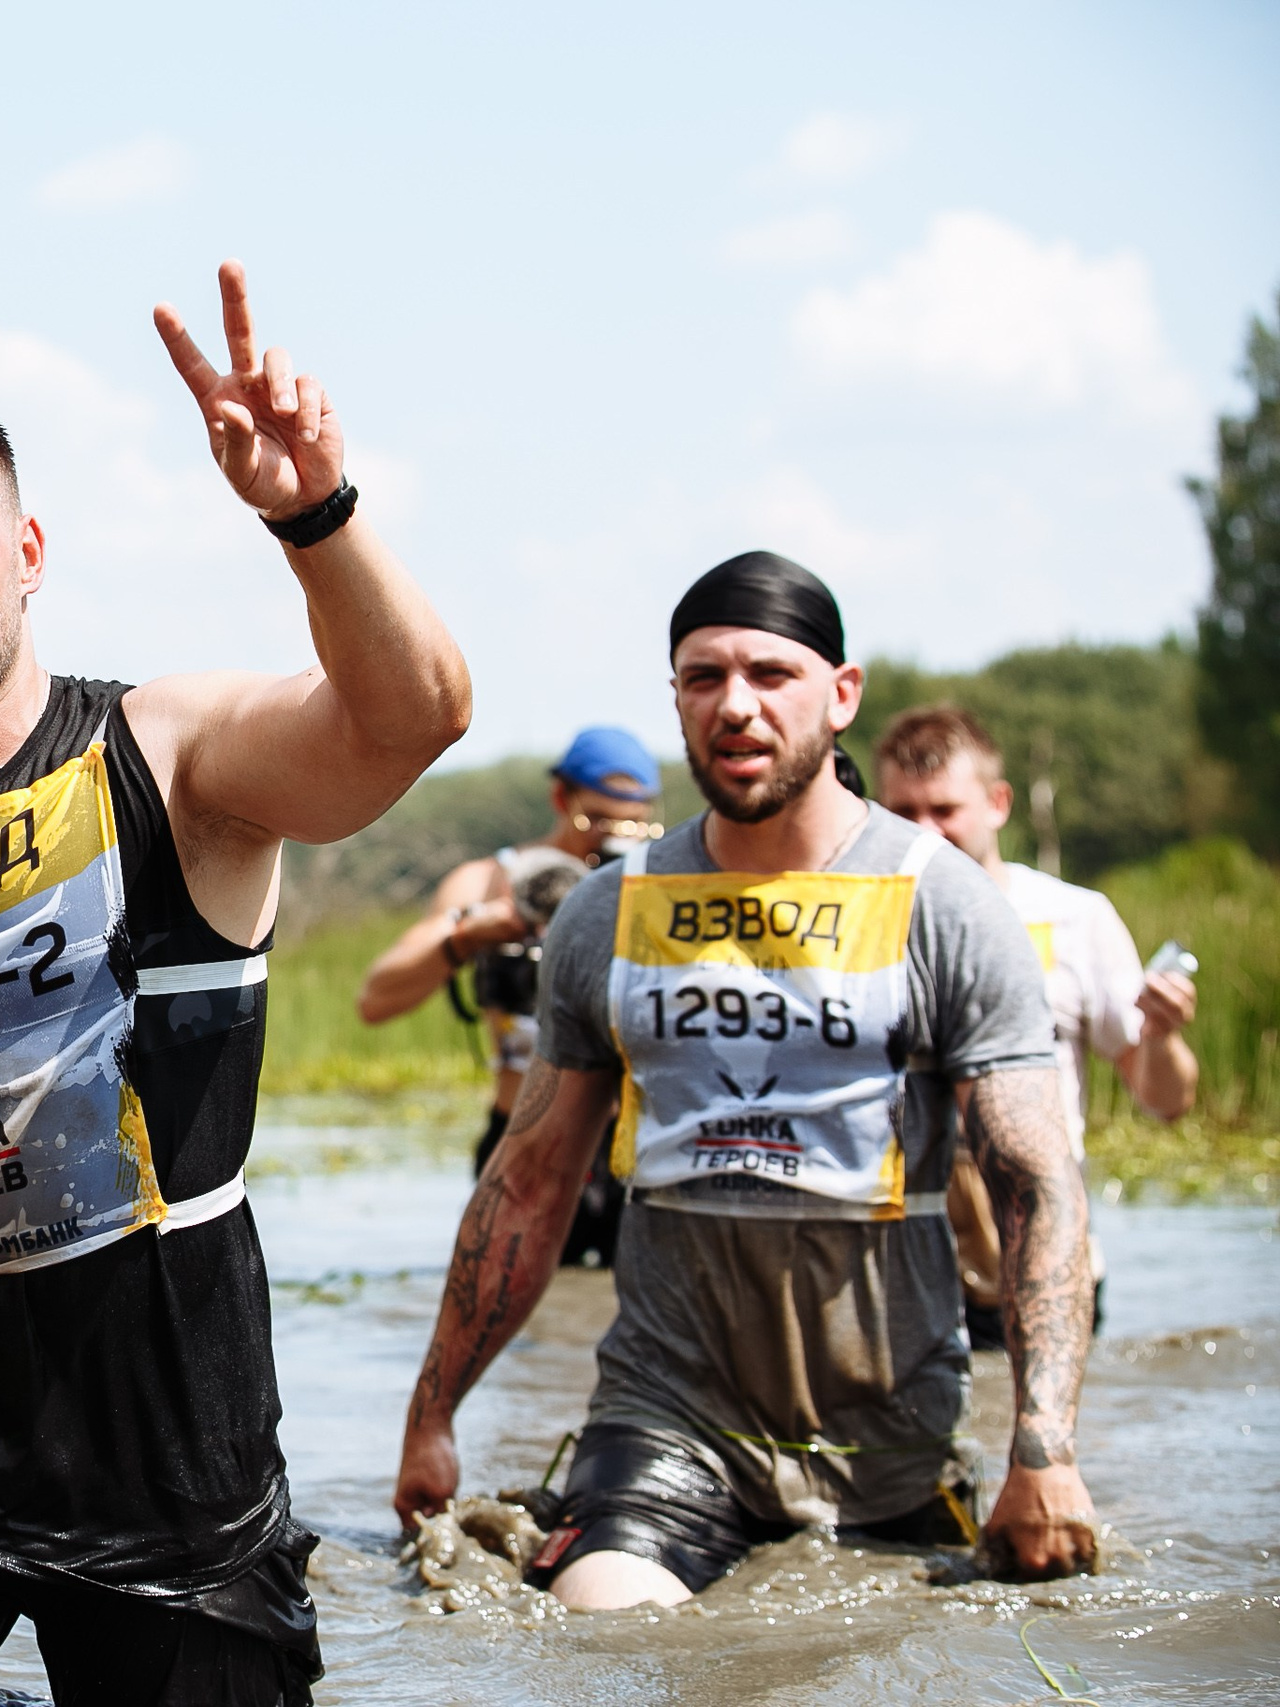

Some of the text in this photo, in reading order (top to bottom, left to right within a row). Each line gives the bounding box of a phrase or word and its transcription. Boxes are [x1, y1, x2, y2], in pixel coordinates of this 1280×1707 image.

[668, 896, 842, 951] ВЗВОД
[647, 986, 857, 1048] 1293-6
[692, 1149, 799, 1178] ГЕРОЕВ
